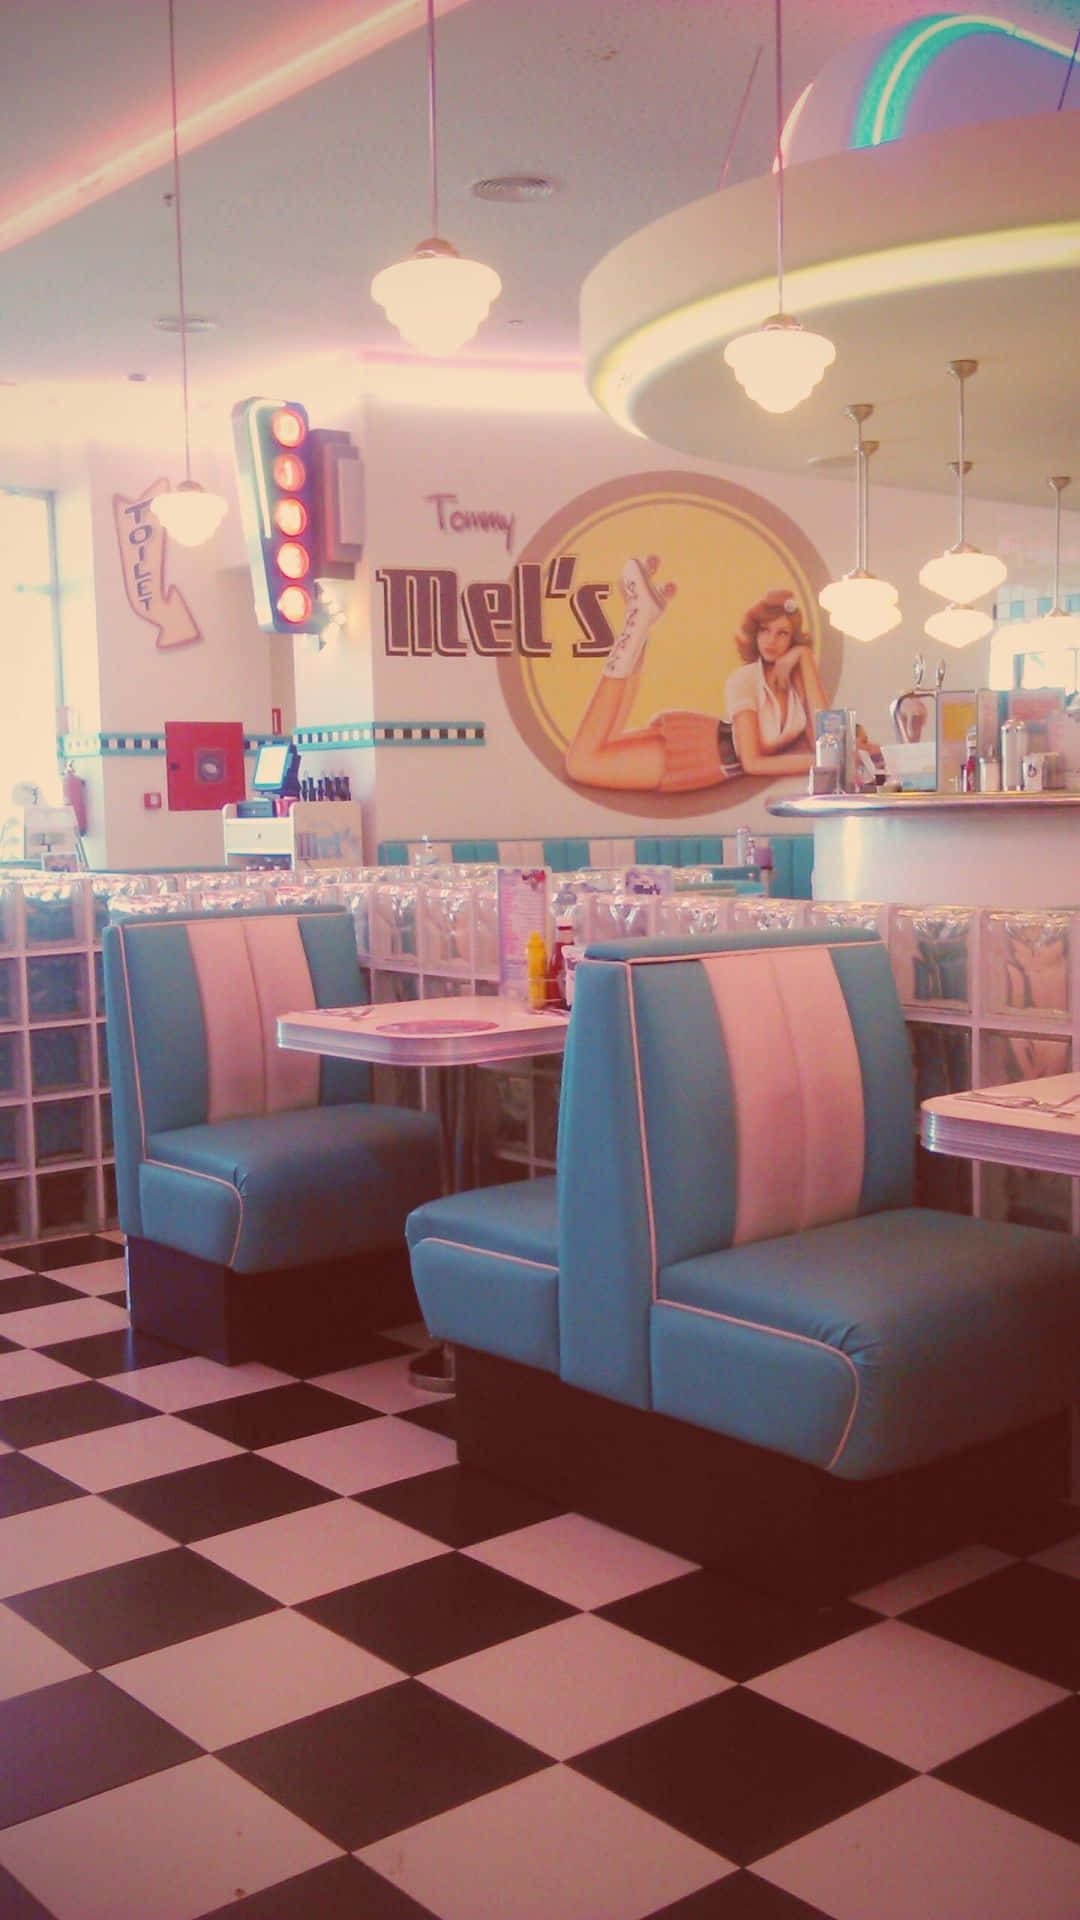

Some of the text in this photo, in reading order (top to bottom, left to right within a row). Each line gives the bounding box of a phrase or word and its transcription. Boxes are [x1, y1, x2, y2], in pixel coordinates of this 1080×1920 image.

[123, 498, 154, 611] TOILET
[423, 493, 516, 556] Tommy
[376, 557, 616, 657] Mel's
